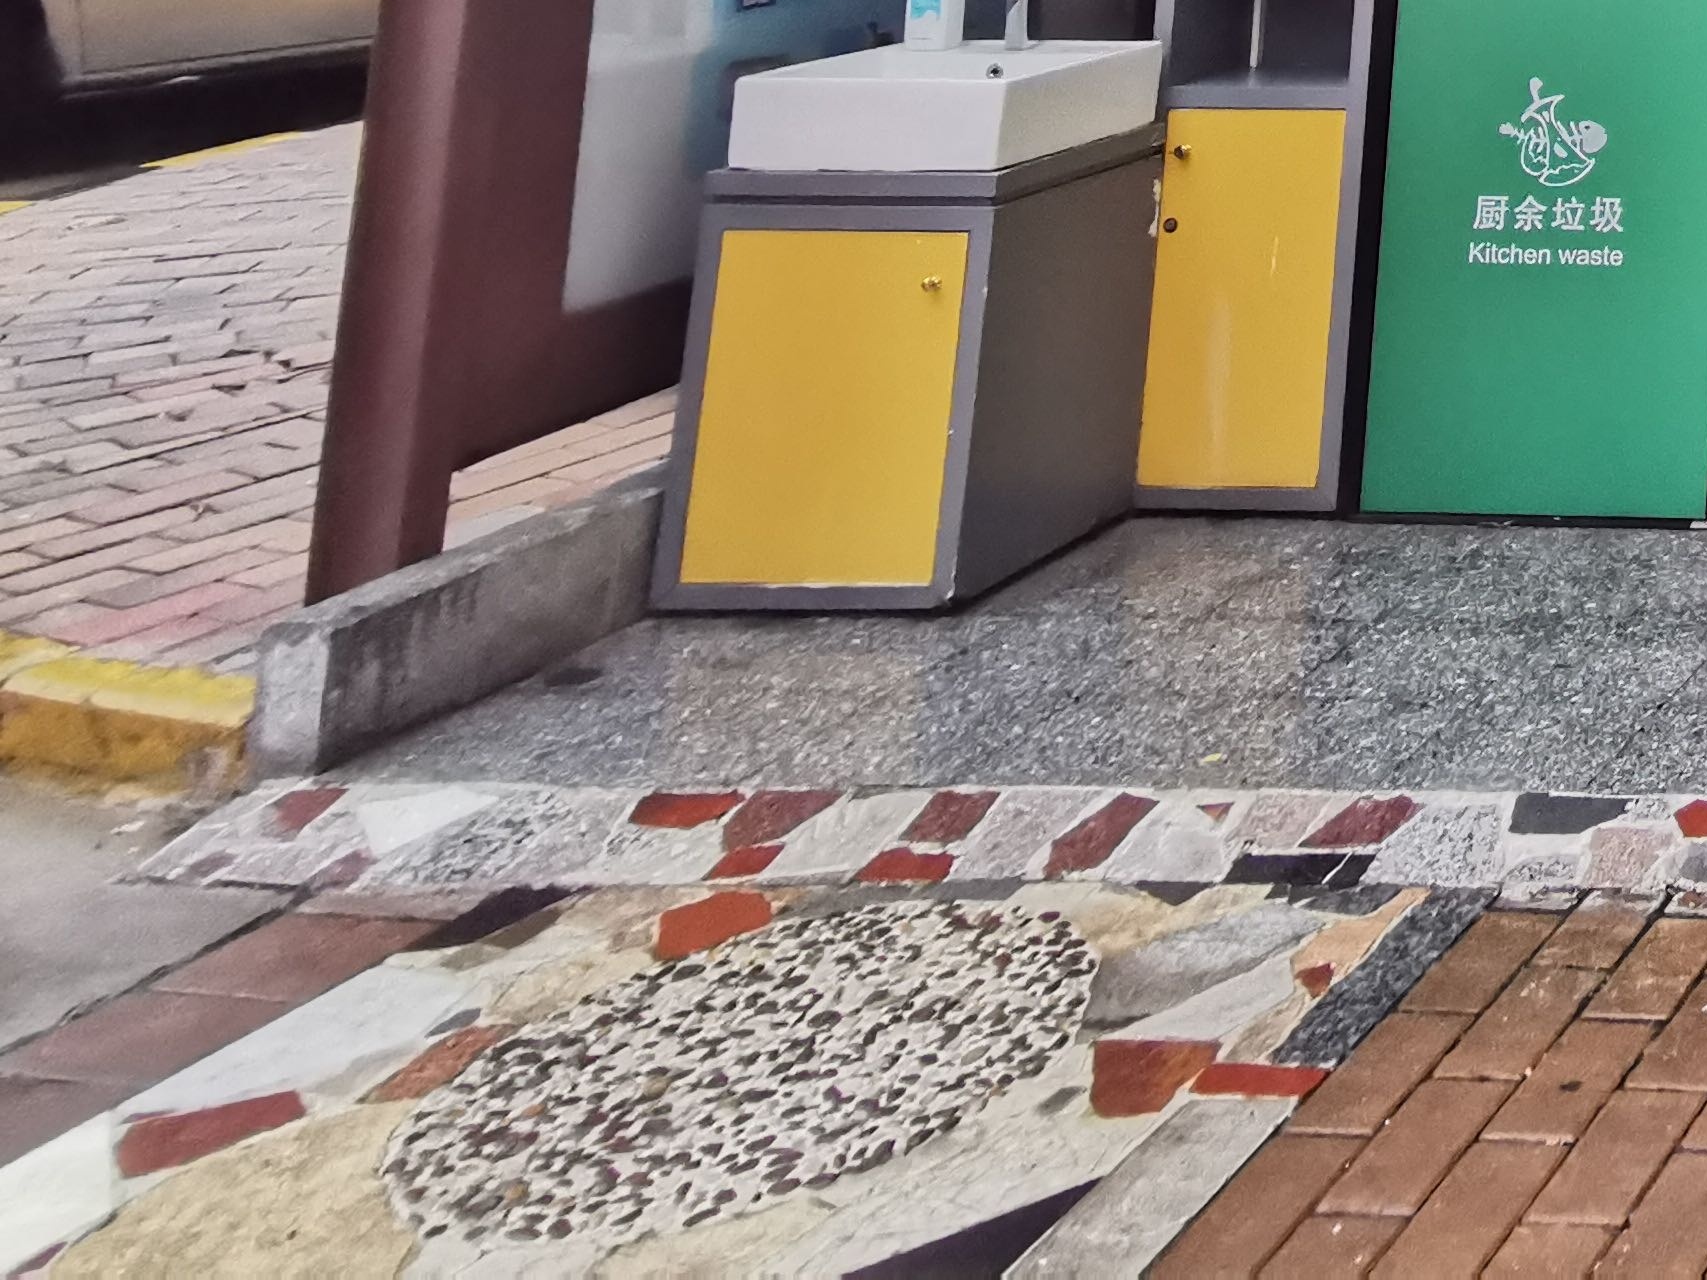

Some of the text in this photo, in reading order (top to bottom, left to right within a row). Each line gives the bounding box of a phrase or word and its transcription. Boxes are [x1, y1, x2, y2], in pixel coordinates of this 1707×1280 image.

[1472, 195, 1624, 233] 厨余垃圾
[1468, 242, 1624, 266] Kitchen waste
